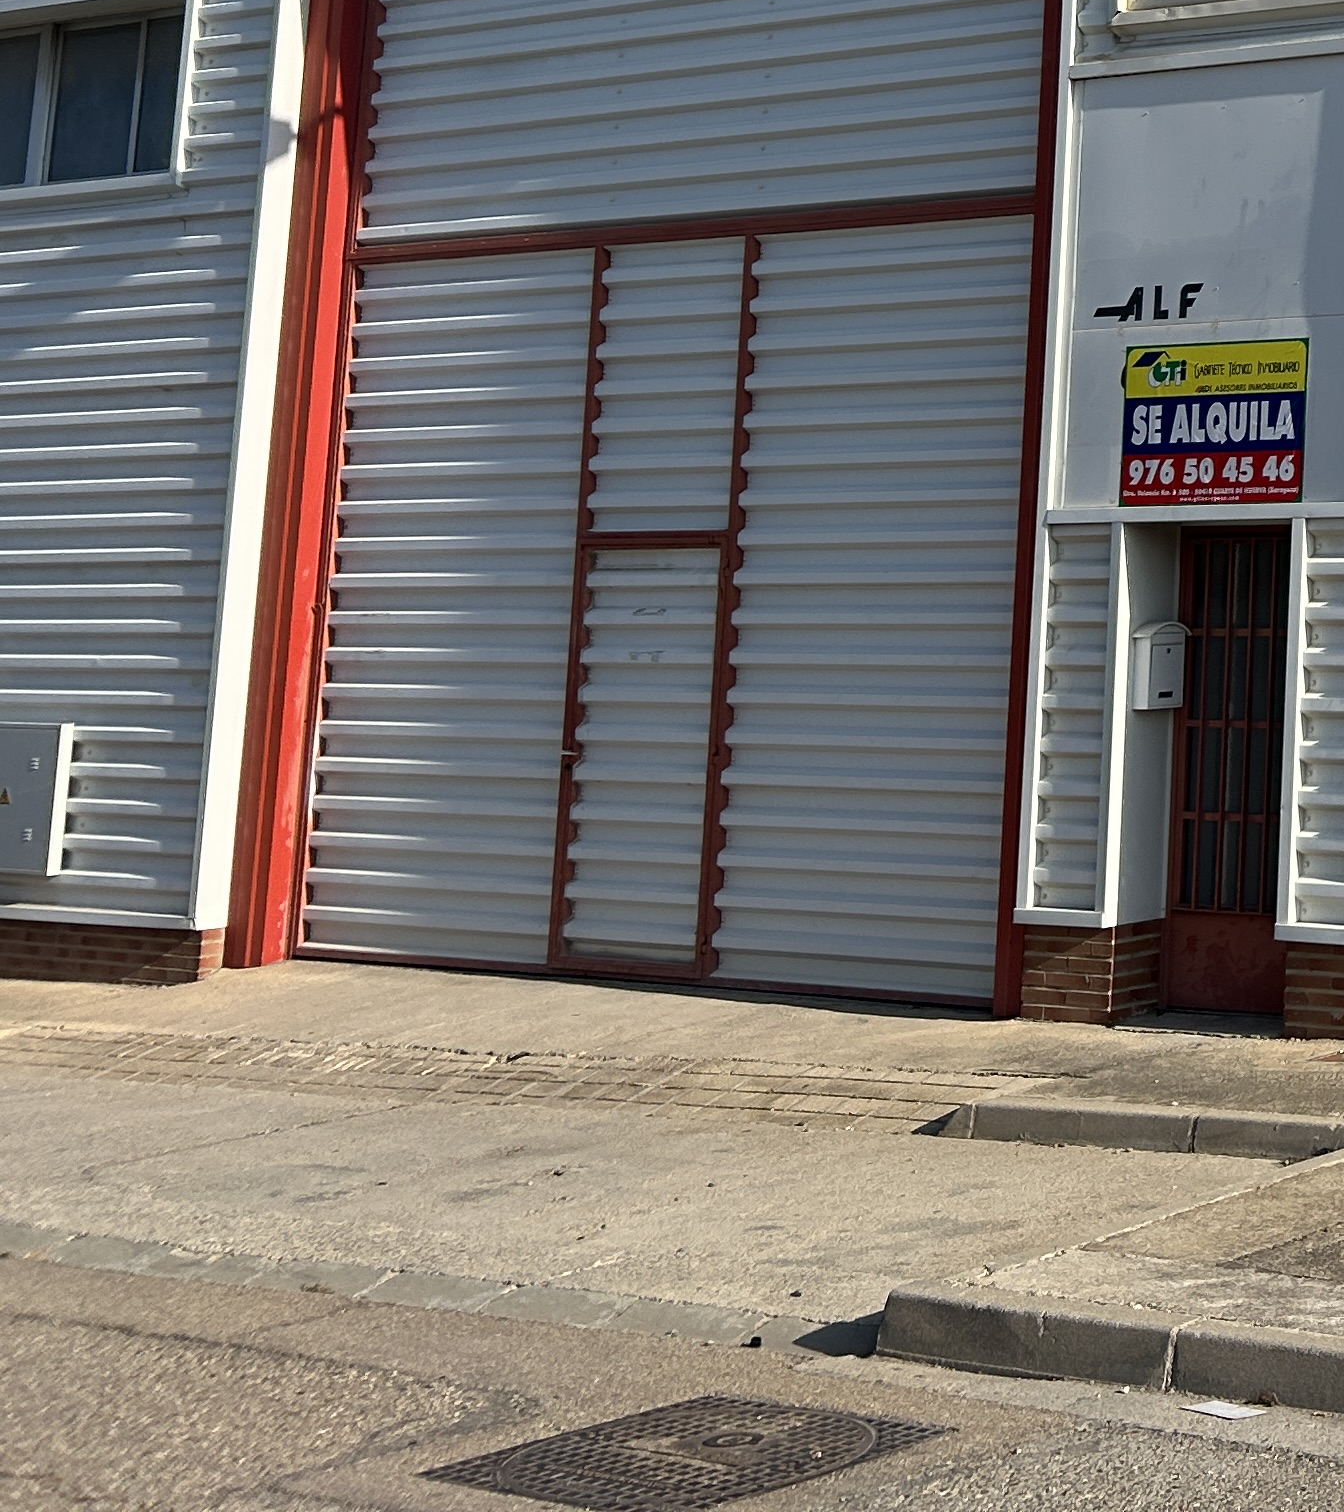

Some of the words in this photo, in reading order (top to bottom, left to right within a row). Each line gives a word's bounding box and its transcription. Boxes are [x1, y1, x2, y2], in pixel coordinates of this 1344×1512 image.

[1131, 404, 1163, 446] SE
[1169, 399, 1296, 445] ALQUILA
[1128, 458, 1176, 486] 976
[1182, 457, 1215, 485] 50
[1222, 456, 1254, 483] 45
[1262, 455, 1295, 482] 46
